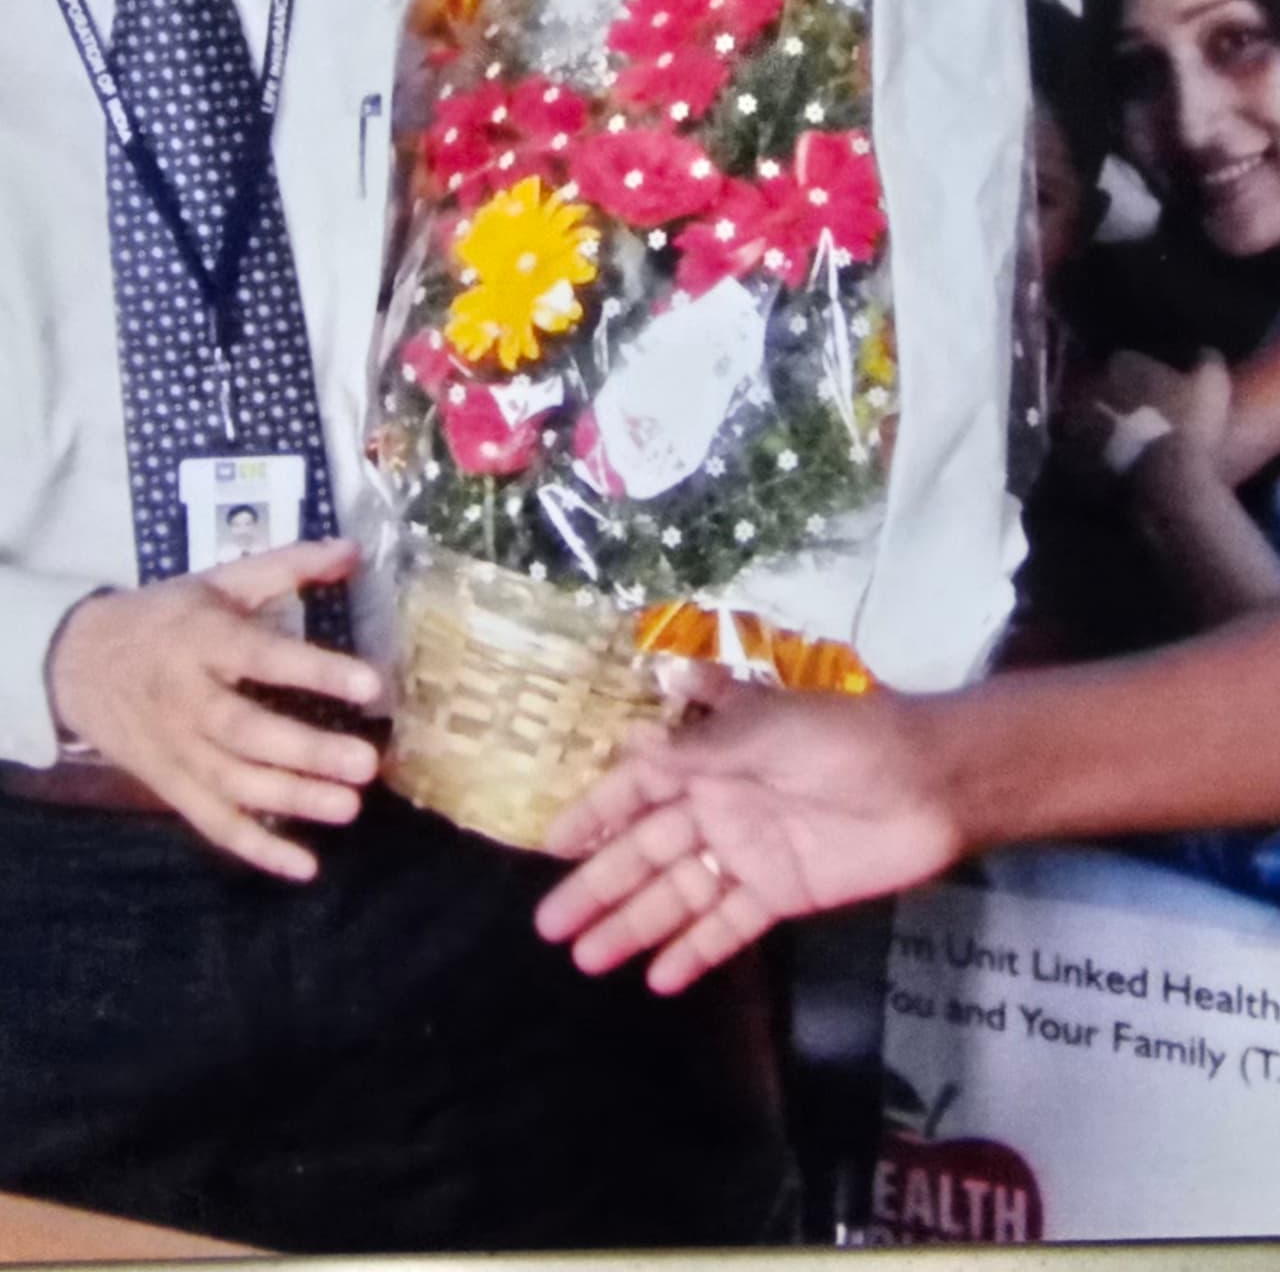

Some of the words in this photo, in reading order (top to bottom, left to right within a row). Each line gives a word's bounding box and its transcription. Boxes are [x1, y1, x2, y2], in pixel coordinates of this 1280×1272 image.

[946, 929, 1021, 977] Unit
[1031, 947, 1149, 1000] Linked
[1163, 970, 1280, 1022] Health
[943, 999, 1007, 1032] and
[1019, 1003, 1099, 1047] Your
[1113, 1021, 1226, 1080] Family
[873, 1159, 1029, 1243] EALTH
